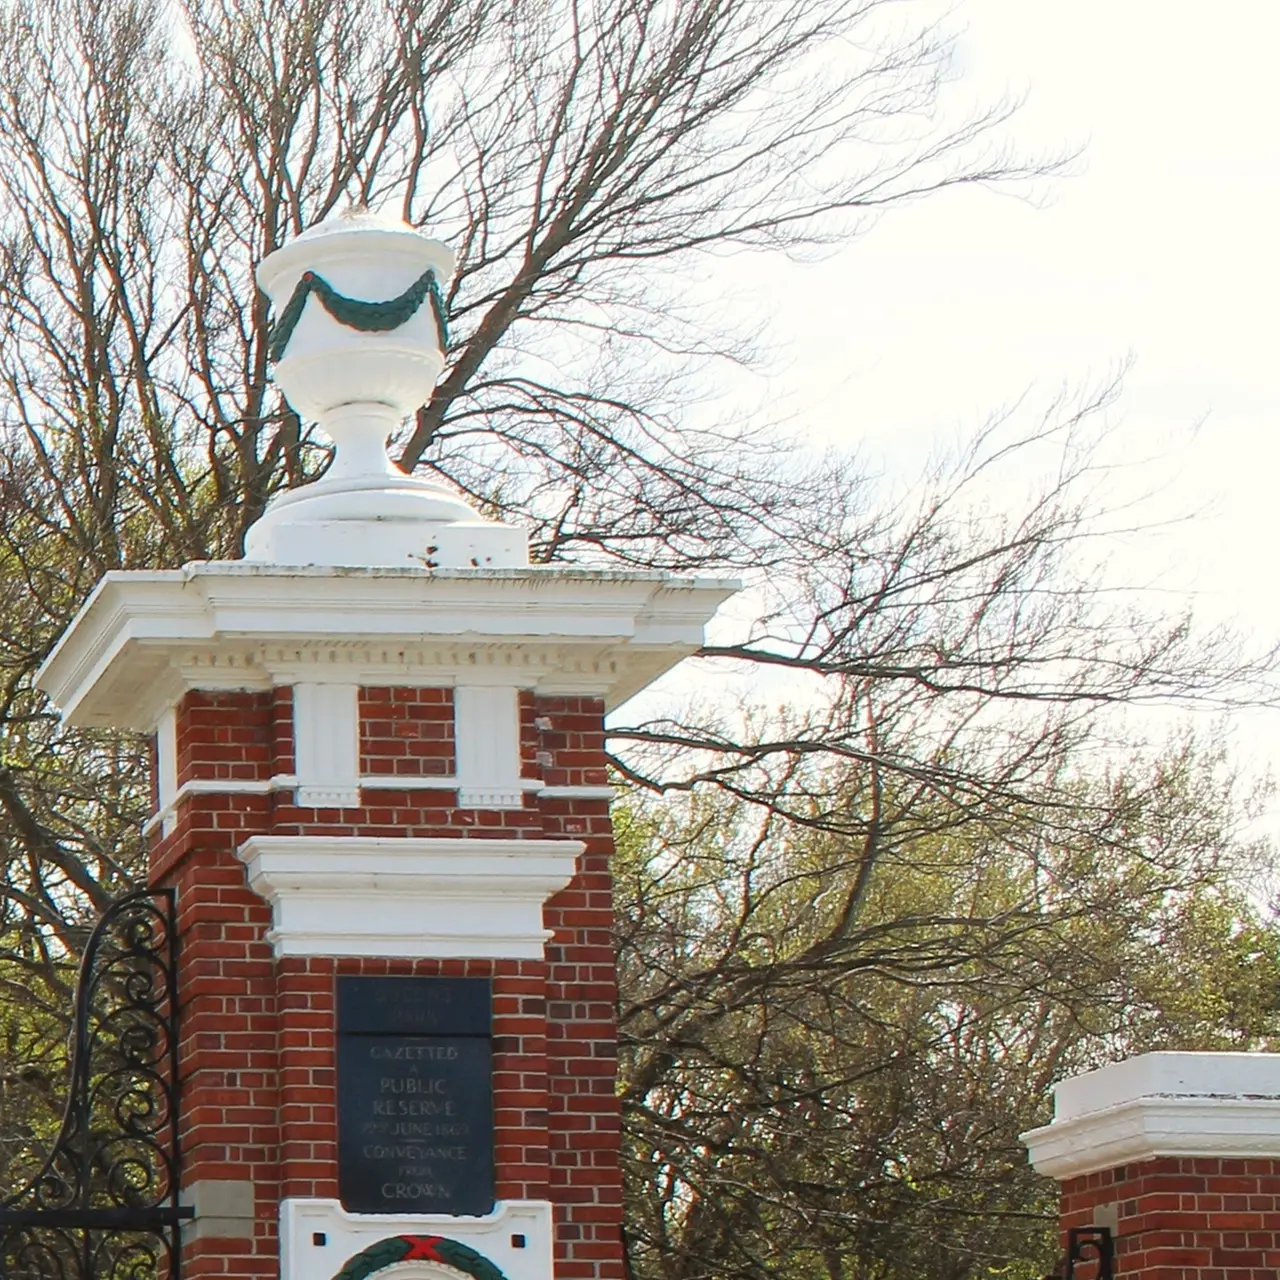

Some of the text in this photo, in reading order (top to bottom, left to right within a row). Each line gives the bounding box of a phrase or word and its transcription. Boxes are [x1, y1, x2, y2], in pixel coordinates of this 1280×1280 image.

[370, 1046, 459, 1060] GAZETTED
[380, 1077, 447, 1094] PUBLIC
[373, 1100, 458, 1116] RESERVE
[390, 1122, 433, 1136] JUNE
[363, 1145, 467, 1160] CONVEYANCE
[381, 1182, 452, 1199] CROWN
